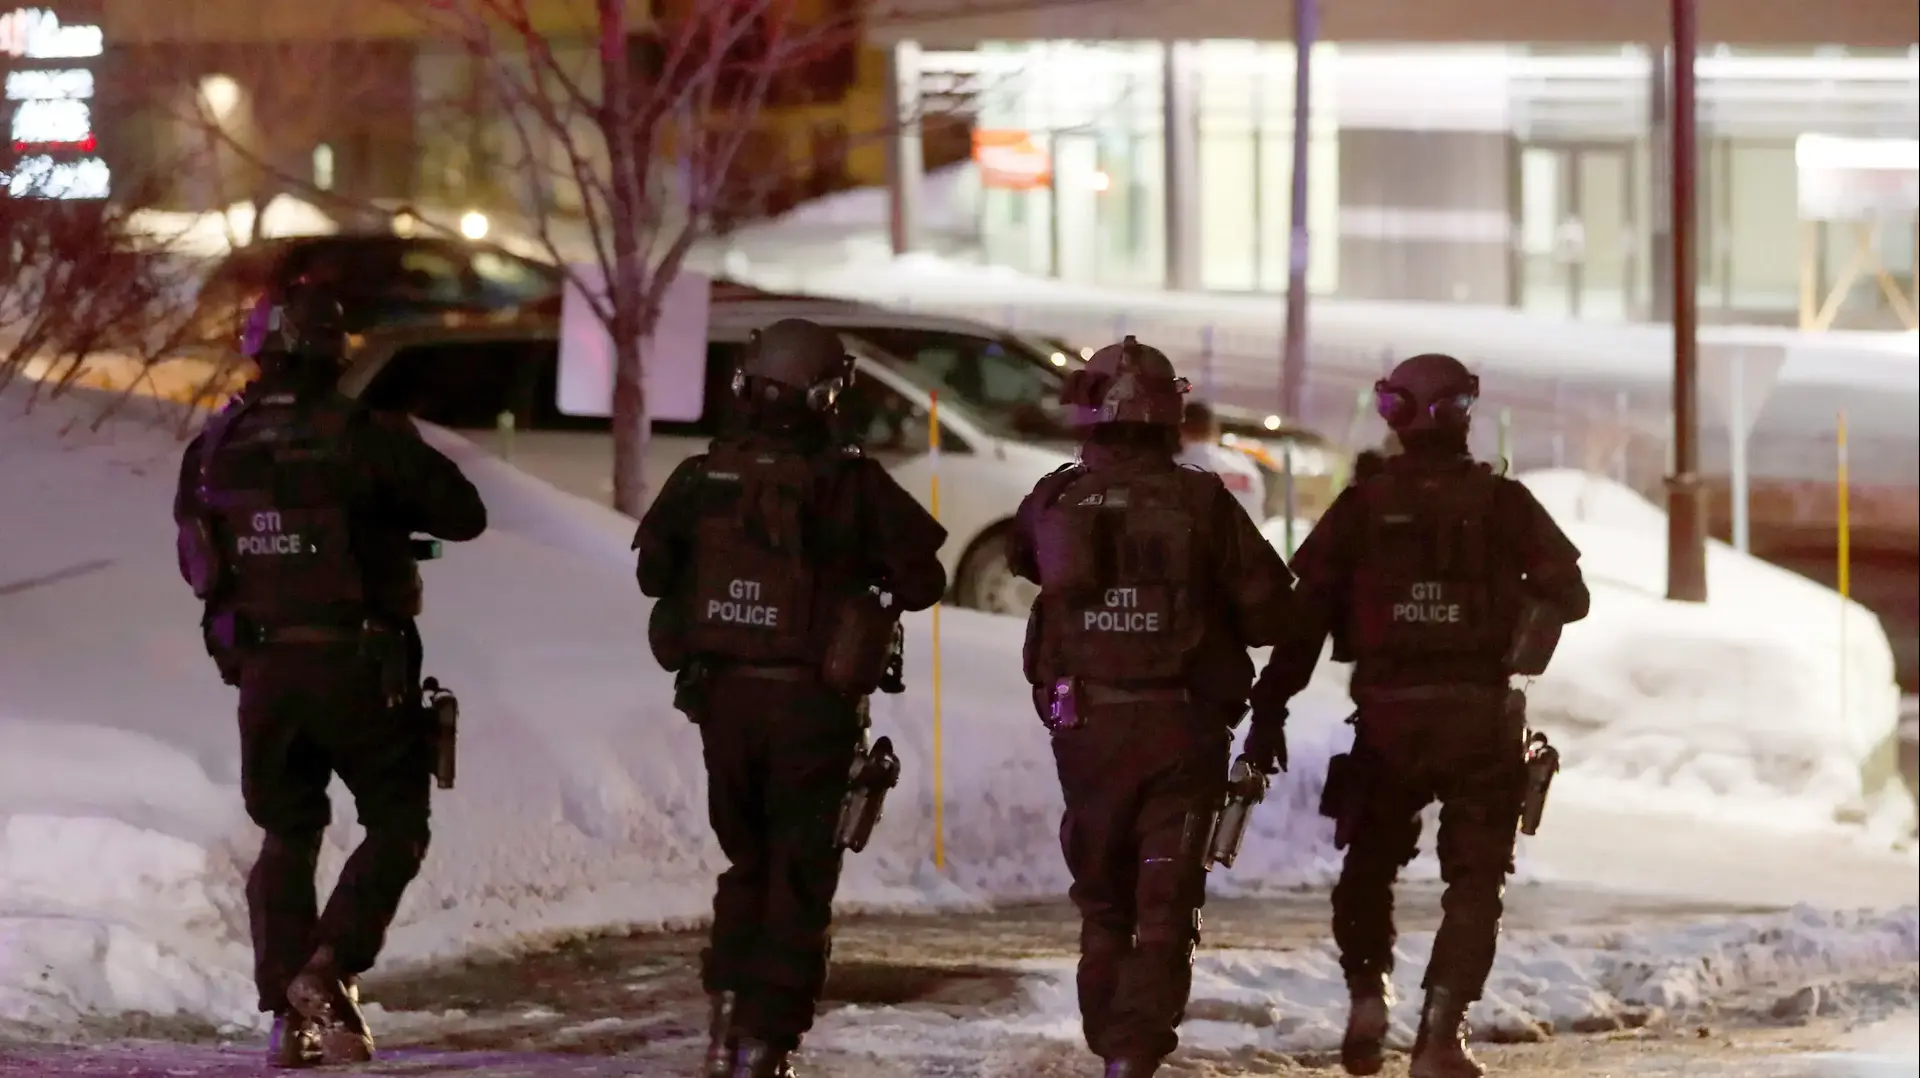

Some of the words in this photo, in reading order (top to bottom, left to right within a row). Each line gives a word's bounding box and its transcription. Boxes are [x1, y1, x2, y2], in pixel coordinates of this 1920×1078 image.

[252, 511, 281, 532] GTI
[237, 534, 300, 555] POLICE
[729, 579, 760, 600] GTI
[1104, 587, 1137, 608] GTI
[1412, 582, 1441, 600] GTI
[707, 599, 778, 626] POLICE
[1084, 611, 1159, 632] POLICE
[1393, 604, 1460, 622] POLICE
